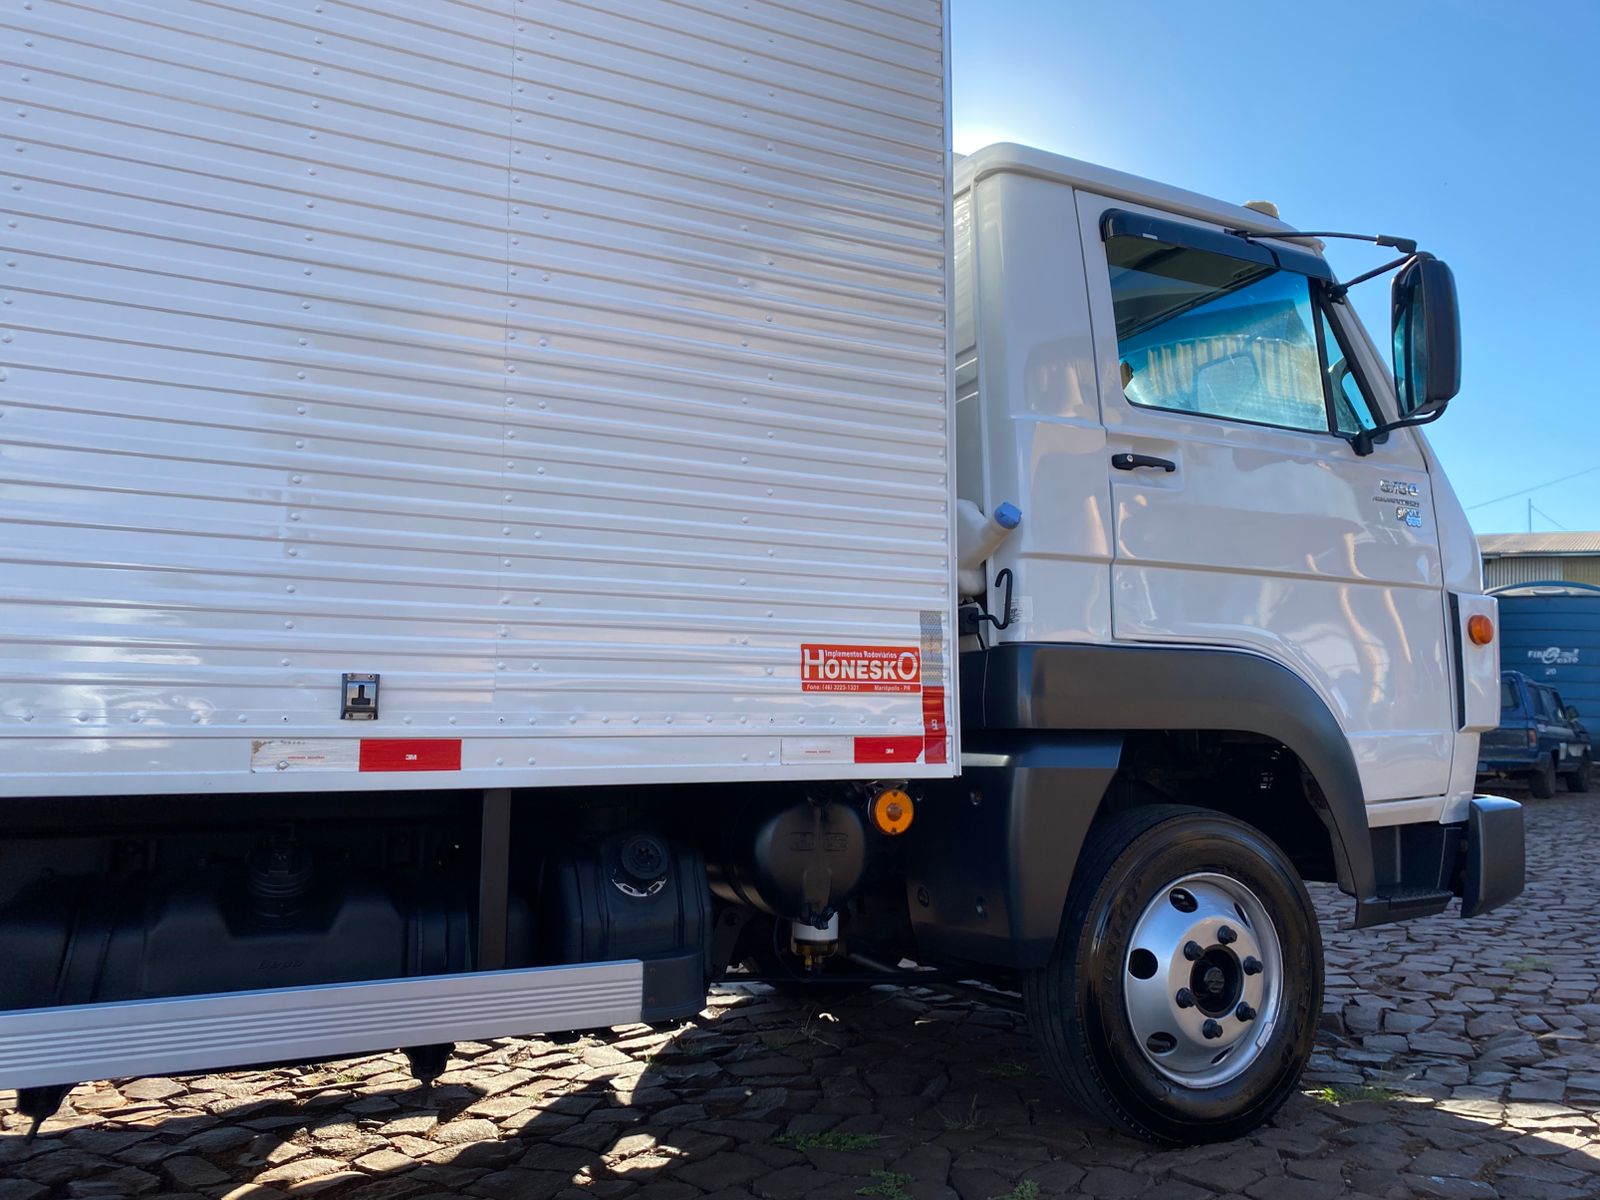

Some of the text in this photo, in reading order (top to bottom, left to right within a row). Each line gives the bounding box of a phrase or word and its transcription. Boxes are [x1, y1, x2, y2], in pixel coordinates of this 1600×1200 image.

[825, 650, 897, 659] Implementos Rodoviários
[804, 649, 917, 680] HONESKO
[405, 753, 417, 761] 3M
